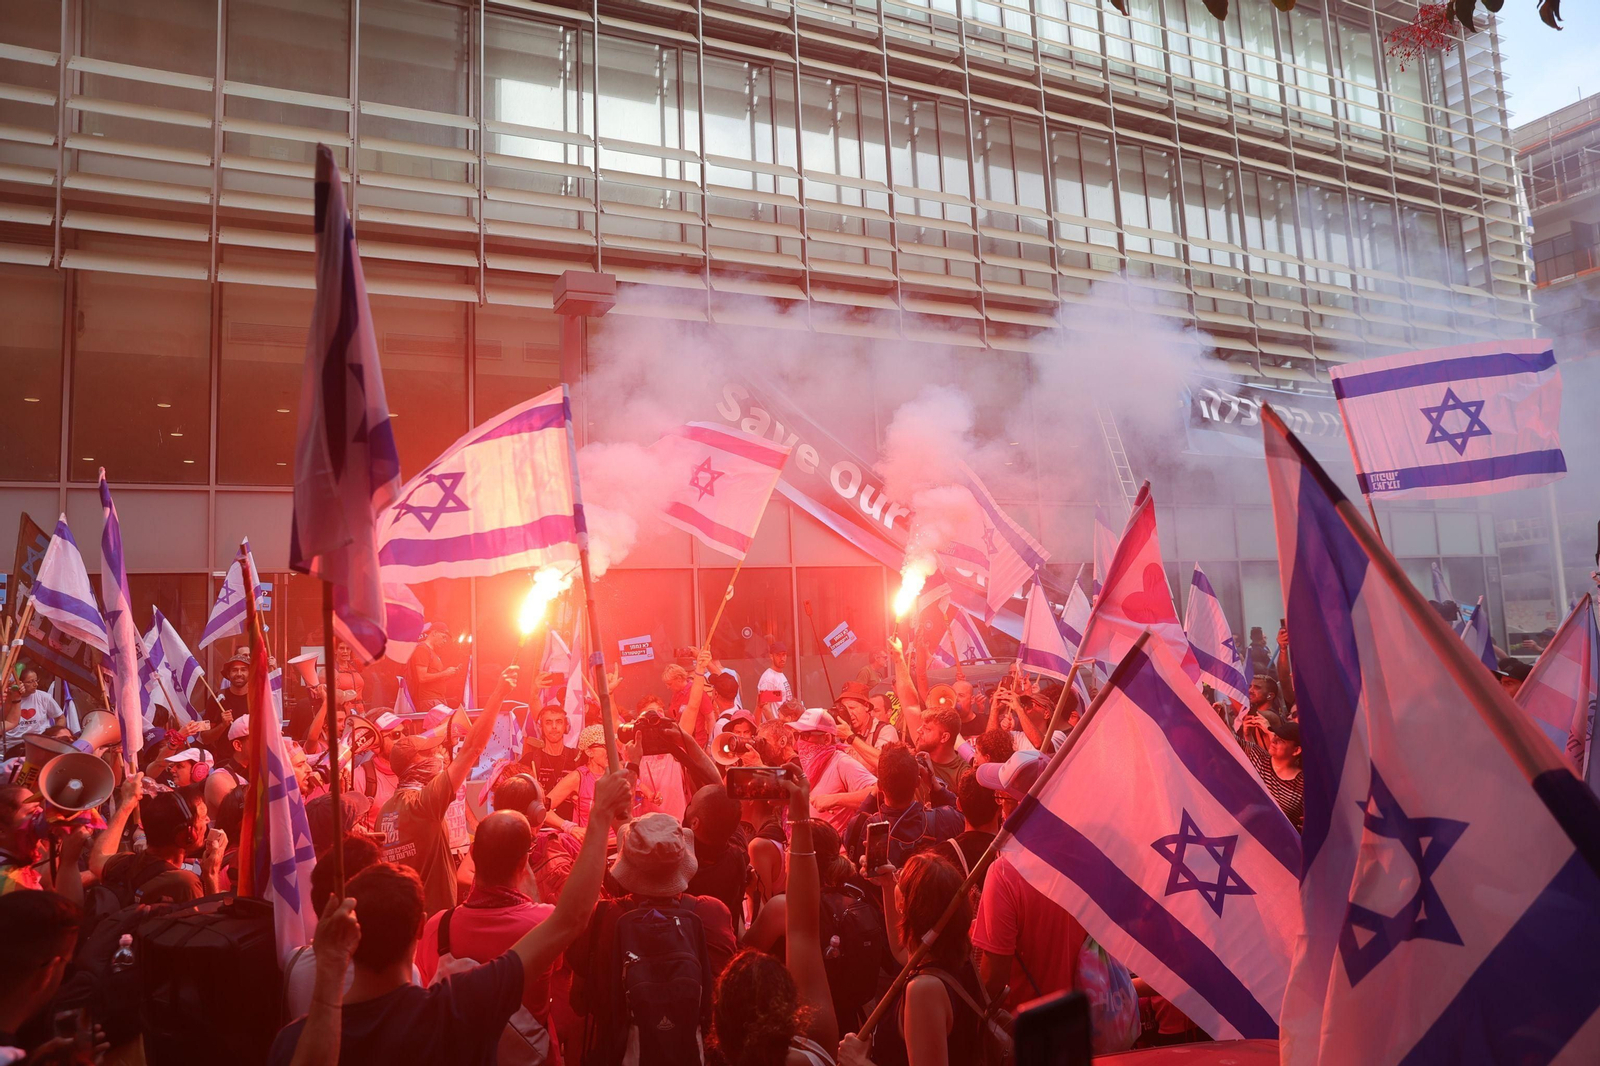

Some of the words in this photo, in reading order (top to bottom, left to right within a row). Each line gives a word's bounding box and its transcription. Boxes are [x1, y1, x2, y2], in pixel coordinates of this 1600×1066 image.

[716, 383, 819, 475] Save
[830, 460, 911, 529] Our
[356, 737, 367, 747] לא
